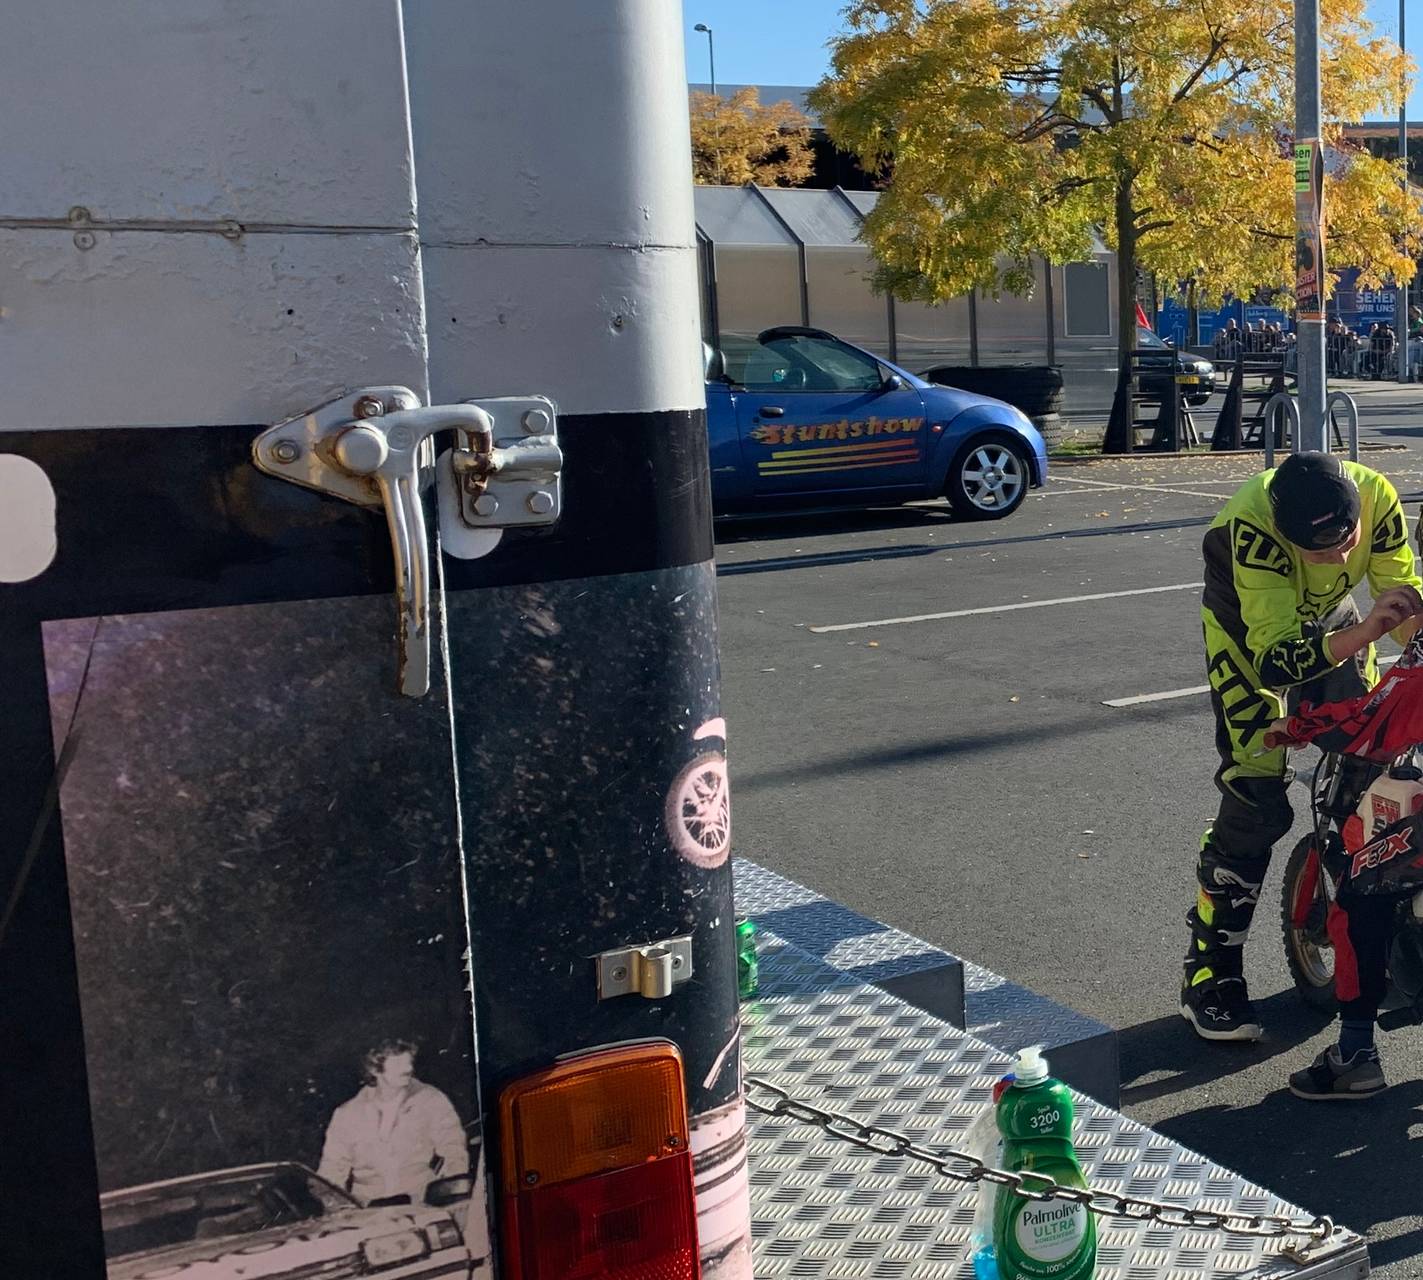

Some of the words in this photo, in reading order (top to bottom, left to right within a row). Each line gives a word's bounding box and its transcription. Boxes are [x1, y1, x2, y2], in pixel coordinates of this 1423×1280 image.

[1376, 304, 1395, 312] UNS
[758, 416, 924, 445] Stuntshow
[1351, 827, 1413, 879] FOX
[1030, 1110, 1060, 1128] 3200
[1023, 1203, 1081, 1226] Palmolive
[1034, 1217, 1076, 1238] ULTRA
